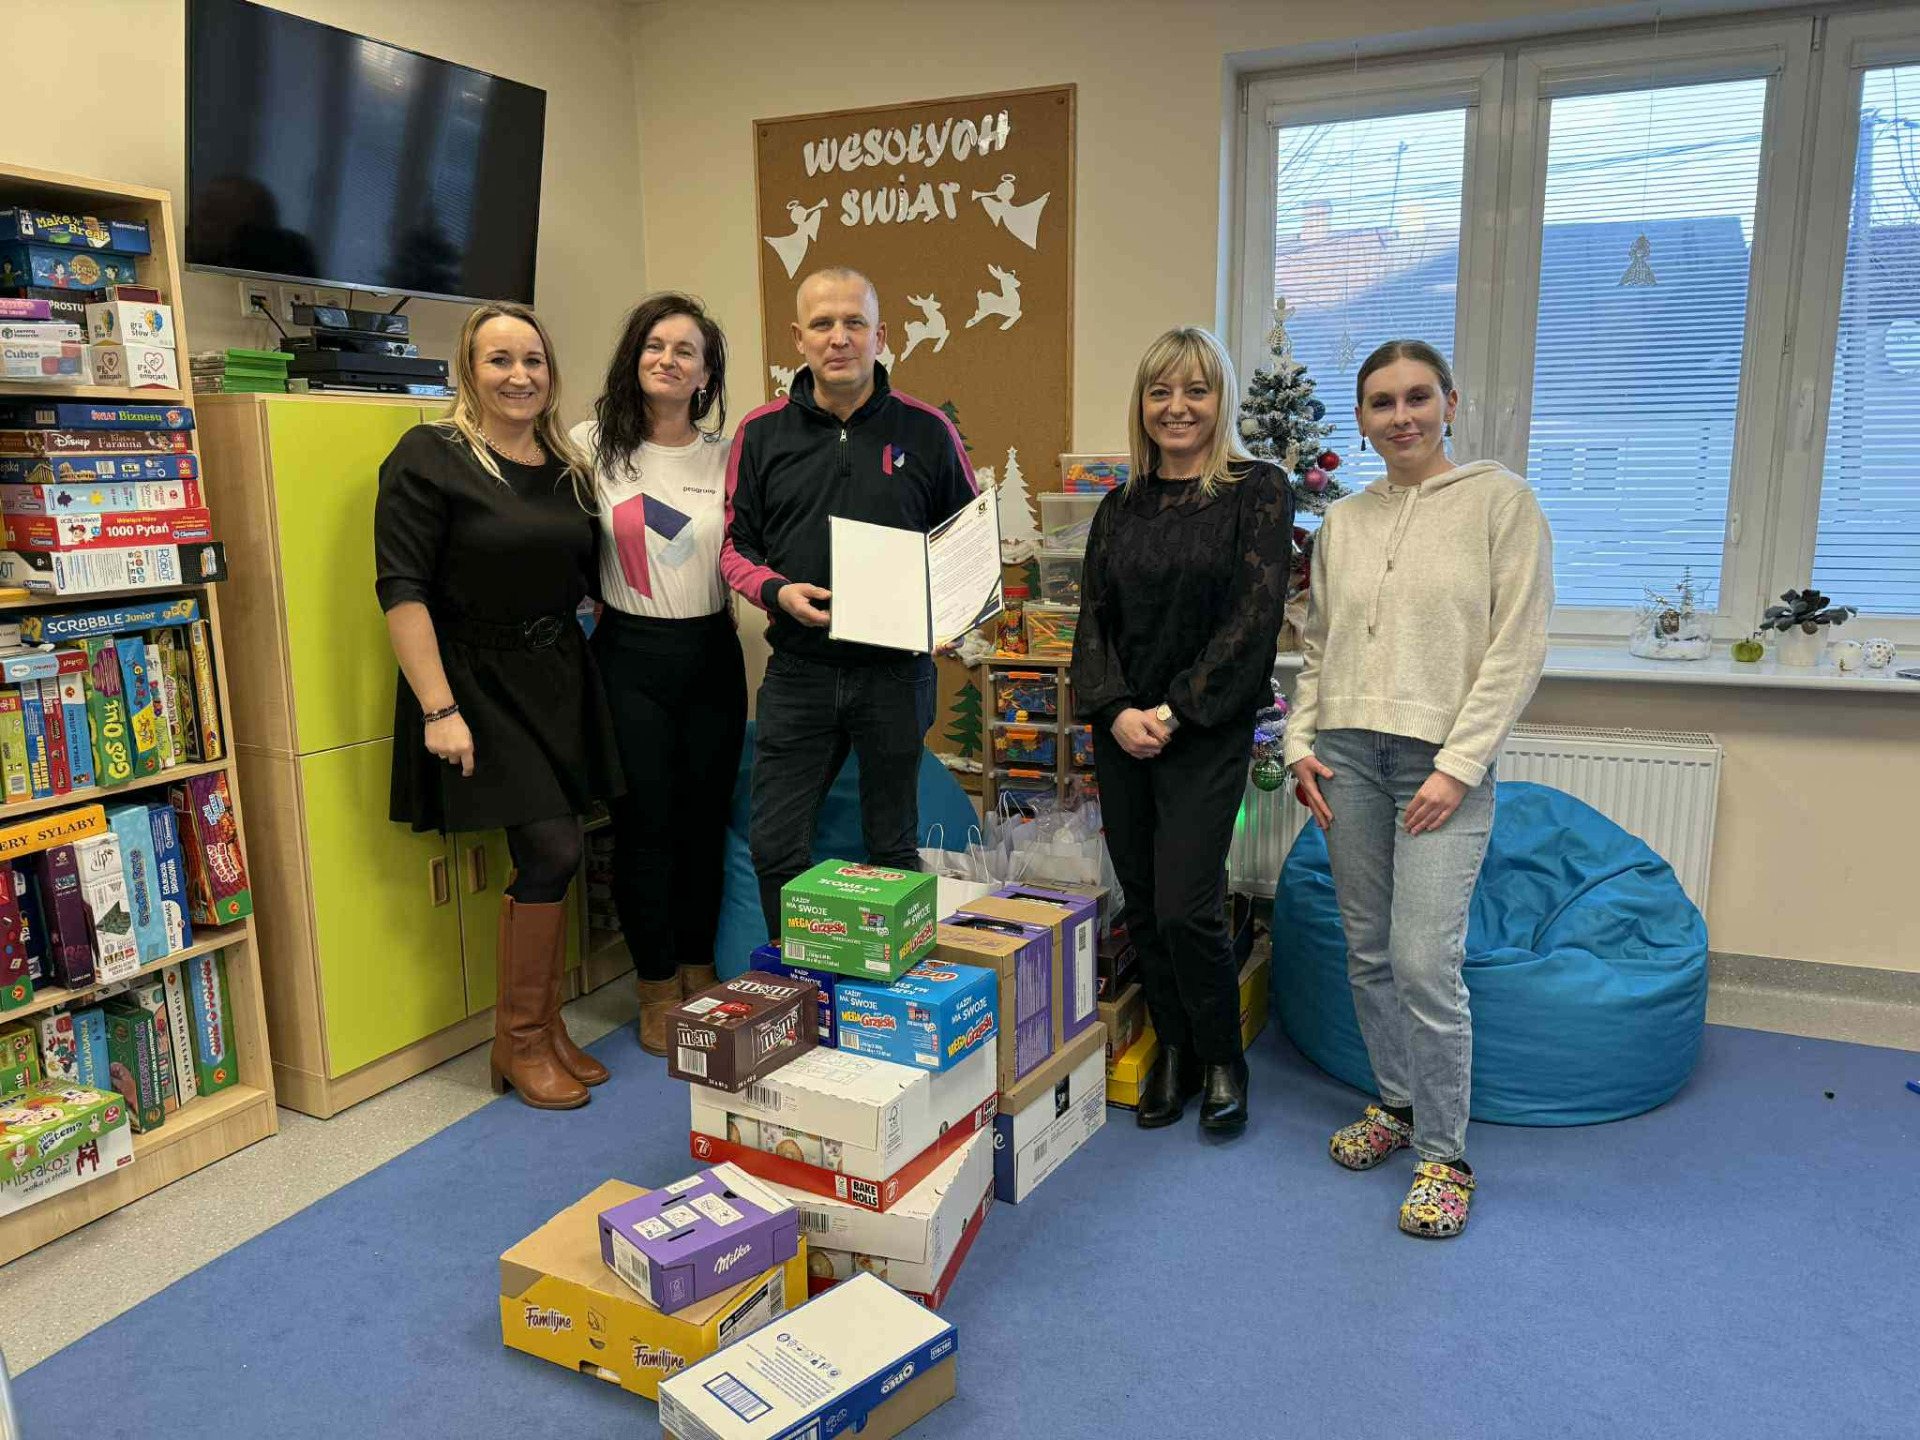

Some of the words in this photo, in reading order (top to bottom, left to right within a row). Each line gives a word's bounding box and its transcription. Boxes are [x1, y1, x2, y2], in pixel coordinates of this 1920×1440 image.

[35, 213, 76, 230] Make
[69, 223, 110, 241] Break
[4, 349, 40, 360] Cubes
[106, 525, 133, 538] 1000
[136, 523, 170, 539] Pytań
[47, 613, 124, 634] SCRABBLE
[38, 816, 96, 842] SYLABY
[798, 904, 828, 916] SWOJE
[787, 918, 809, 929] MEGA
[850, 996, 878, 1010] SWOJE
[963, 997, 988, 1021] SWOJE
[40, 1122, 83, 1156] jestem?
[852, 1180, 878, 1197] BAKE
[852, 1190, 878, 1207] ROLLS
[713, 1244, 752, 1275] Milka
[525, 1306, 573, 1333] Familijne
[633, 1345, 687, 1372] Familijne
